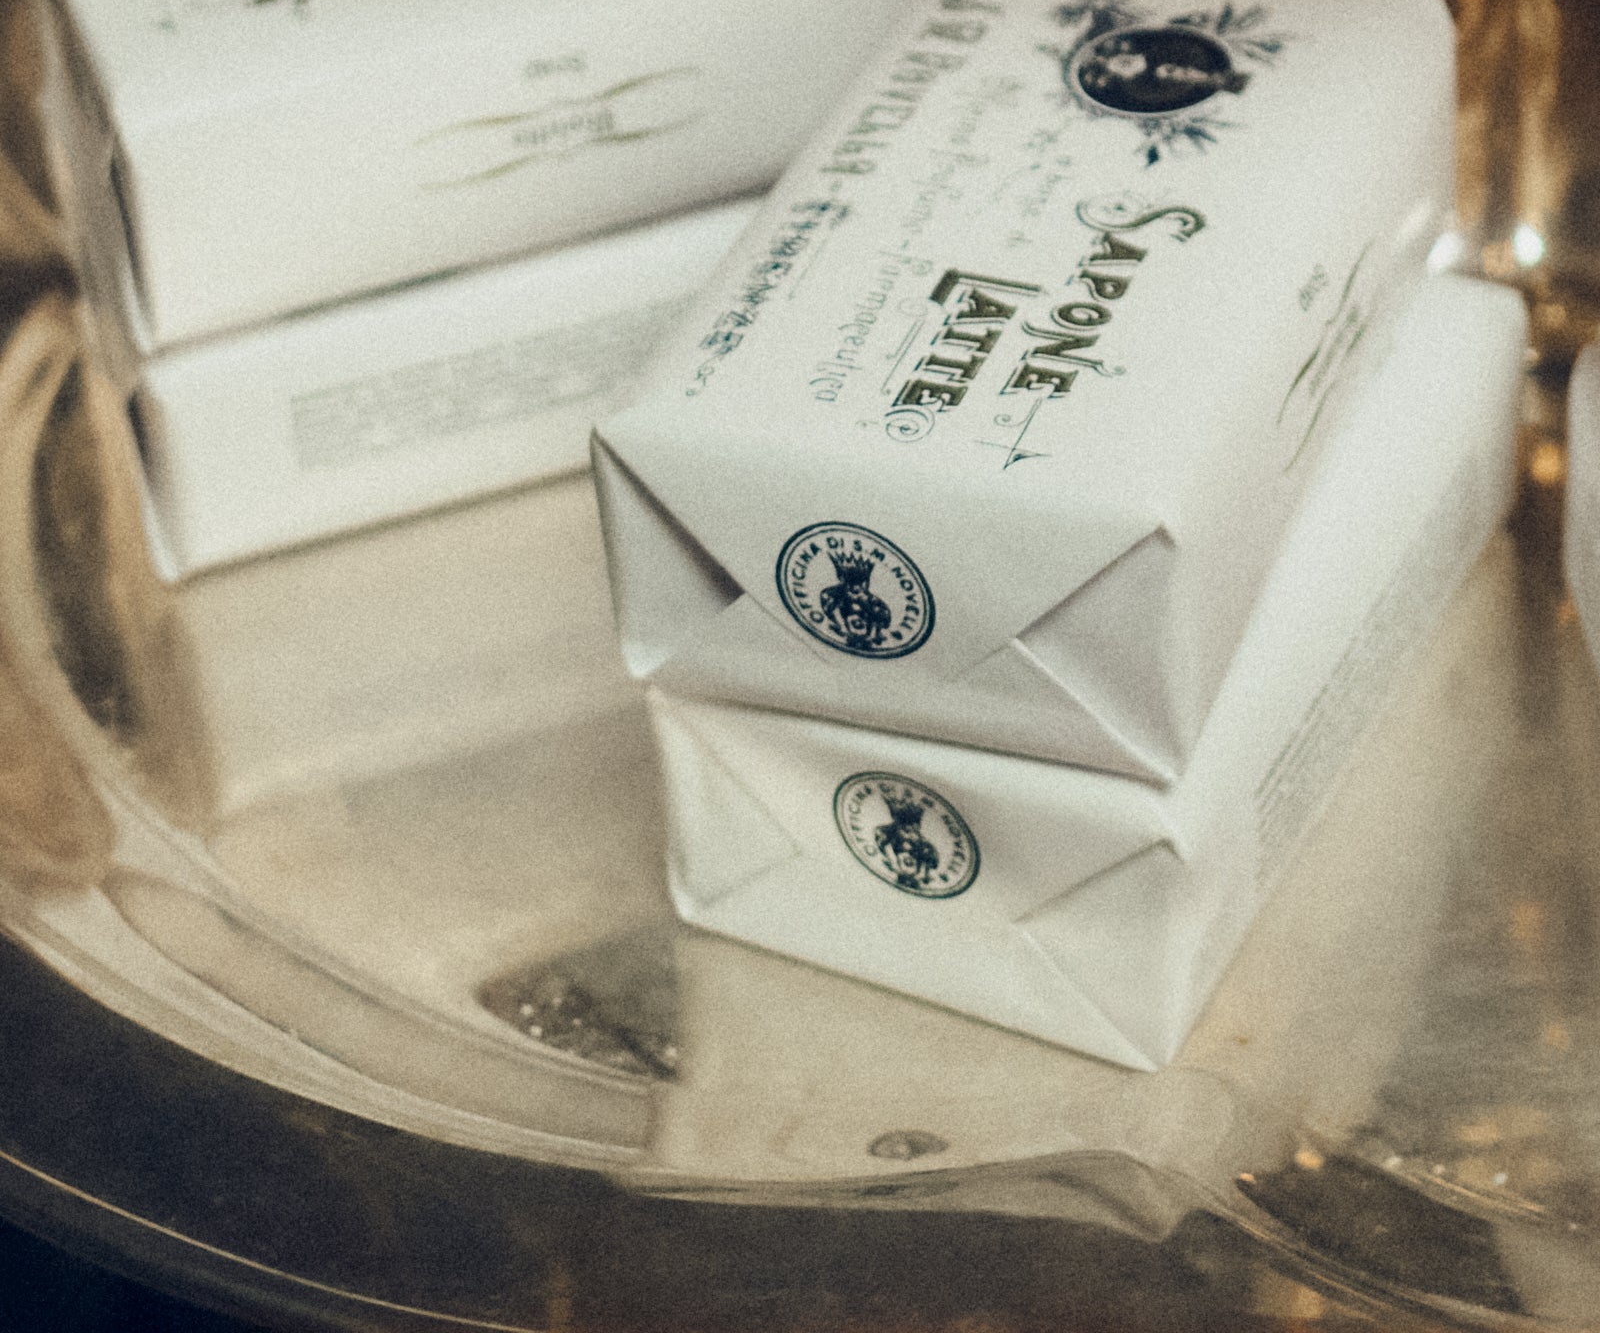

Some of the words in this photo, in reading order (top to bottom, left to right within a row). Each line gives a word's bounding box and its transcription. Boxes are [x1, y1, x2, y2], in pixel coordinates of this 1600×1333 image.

[886, 268, 1052, 441] LATTE
[999, 199, 1207, 397] SAPONE
[792, 545, 826, 625] OFFICINA
[826, 535, 846, 550] DI
